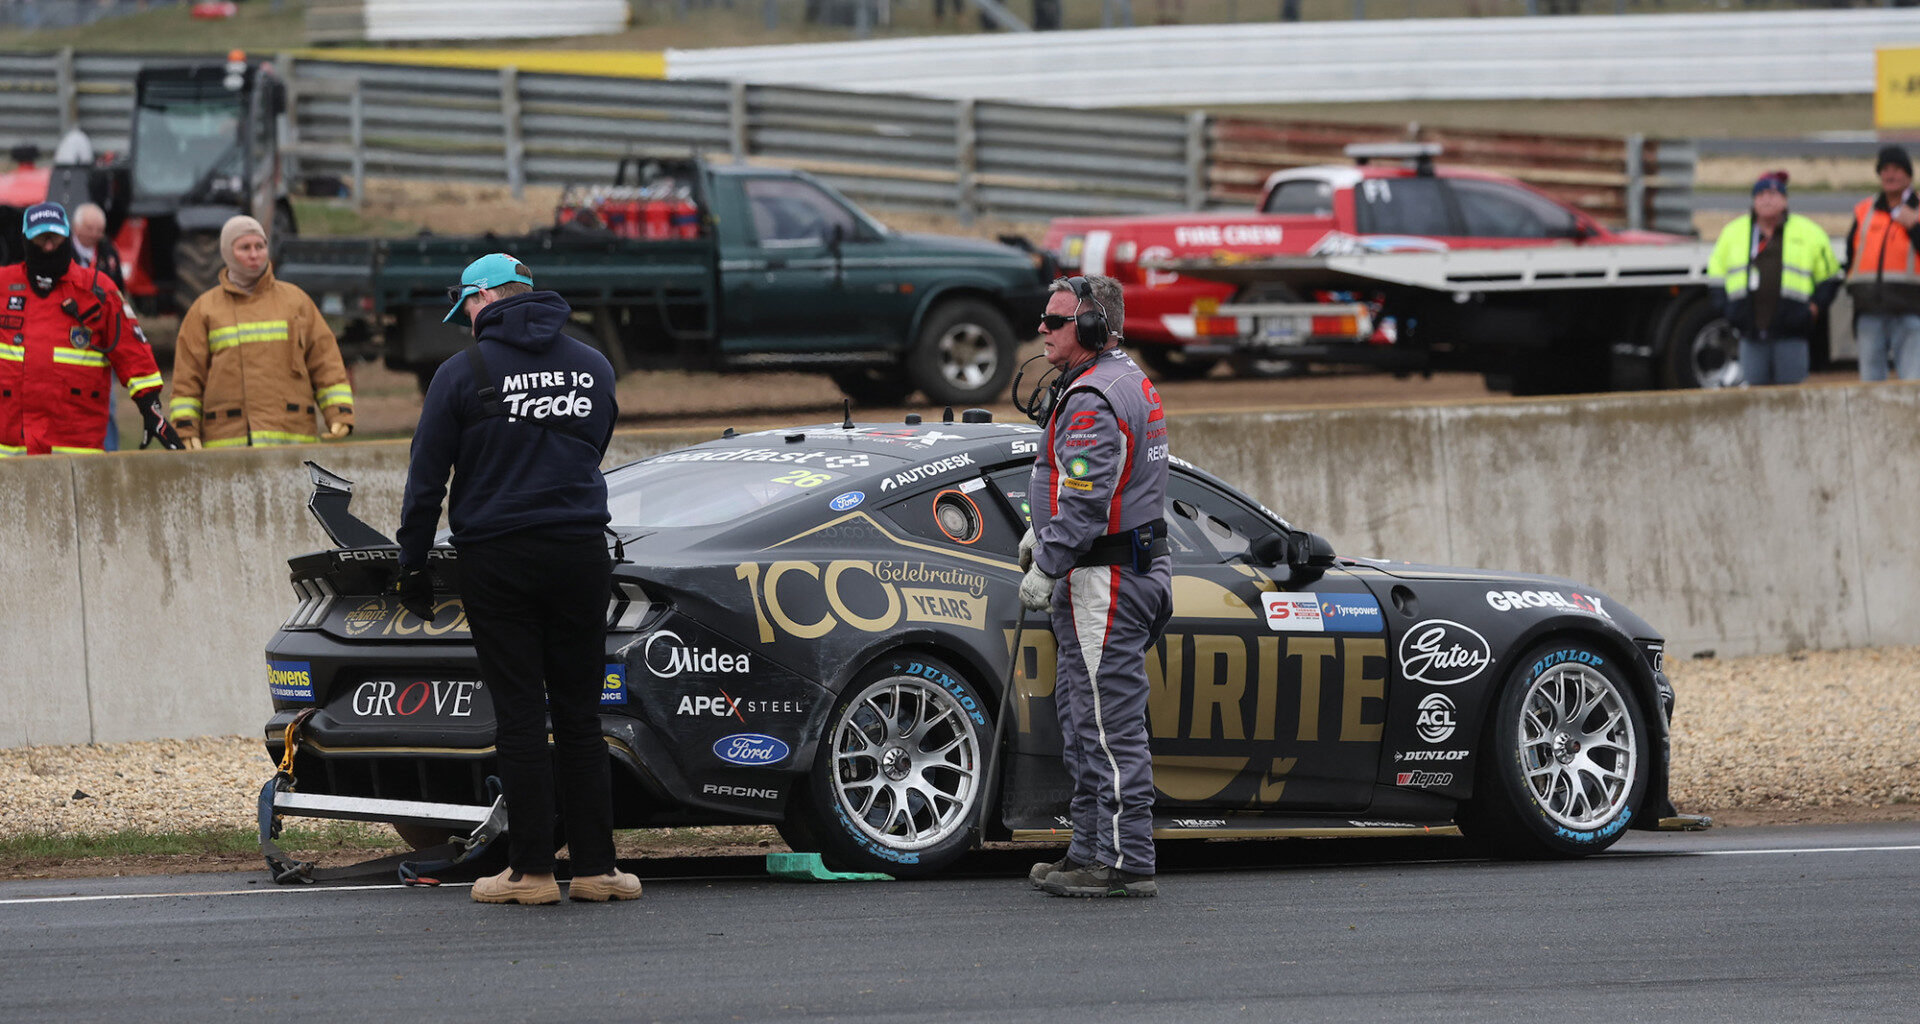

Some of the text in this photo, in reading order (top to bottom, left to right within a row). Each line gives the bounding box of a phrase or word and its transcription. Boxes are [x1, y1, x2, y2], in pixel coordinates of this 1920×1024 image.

[30, 210, 60, 222] OFFICIAL
[1175, 225, 1283, 246] FIRE CREW
[502, 371, 594, 392] MITRE 10
[503, 390, 592, 422] Trade
[771, 470, 832, 488] 26
[896, 452, 976, 486] AUTODESK
[836, 493, 859, 508] Ford
[875, 560, 988, 596] Celebrating
[345, 610, 388, 622] PENRITE
[913, 595, 973, 621] YEARS
[1335, 604, 1378, 617] Tyrepower
[655, 640, 750, 676] Midea
[1532, 649, 1604, 678] DUNLOP
[267, 664, 311, 686] Bowens
[1003, 629, 1386, 741] PNRITE
[352, 680, 475, 717] GROVE
[906, 662, 986, 726] DUNLOP
[677, 690, 803, 721] APEX STEEL
[1417, 711, 1456, 726] ACL
[727, 737, 775, 761] Ford
[1404, 750, 1469, 761] DUNLOP
[1409, 770, 1453, 787] Repco
[703, 784, 779, 799] RACING
